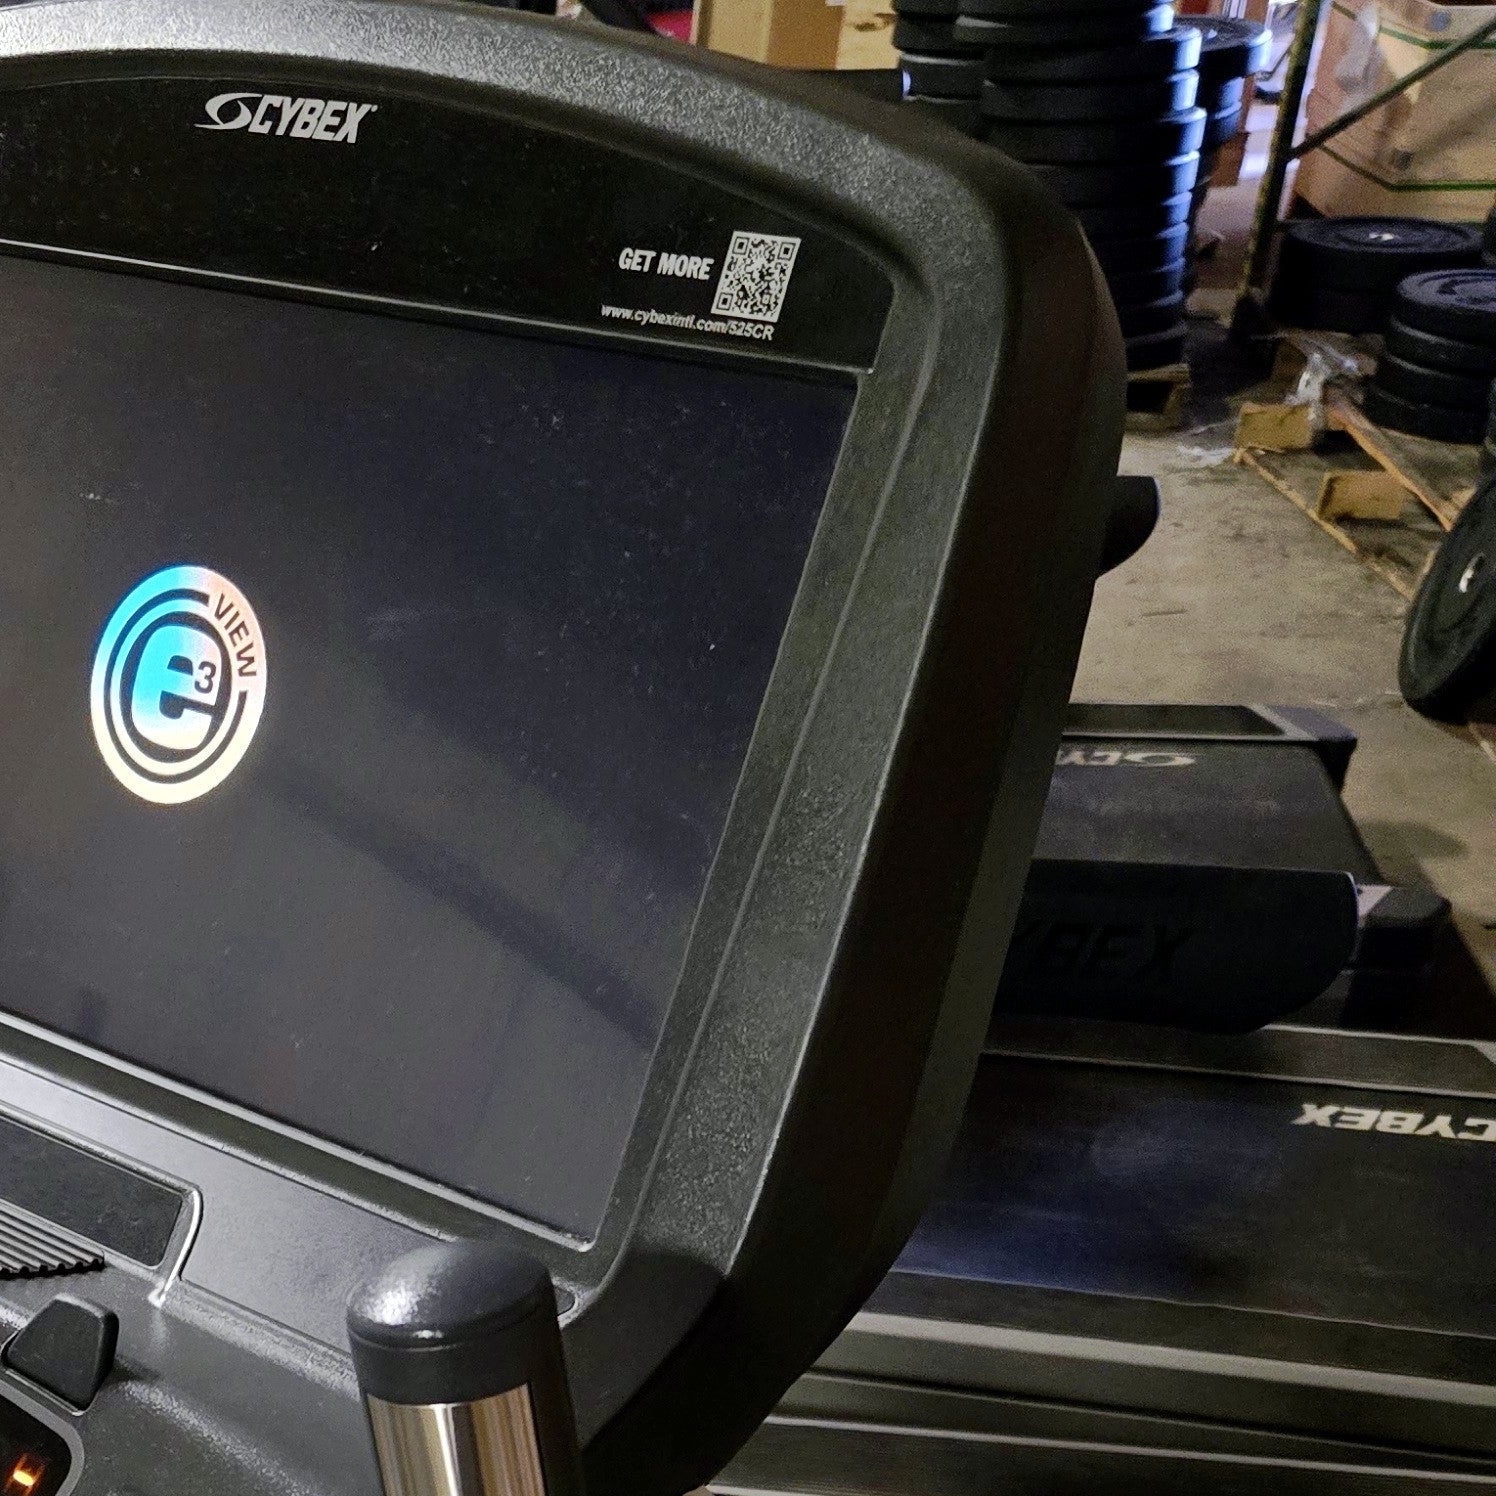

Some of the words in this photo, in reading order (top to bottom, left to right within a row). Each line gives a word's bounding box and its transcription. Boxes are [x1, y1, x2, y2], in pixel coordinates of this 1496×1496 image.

[247, 94, 373, 144] CYBEX
[618, 247, 657, 273] GET
[656, 252, 714, 281] MORE
[601, 304, 775, 341] www.cybexintl.com/525CR
[213, 593, 257, 678] VIEW
